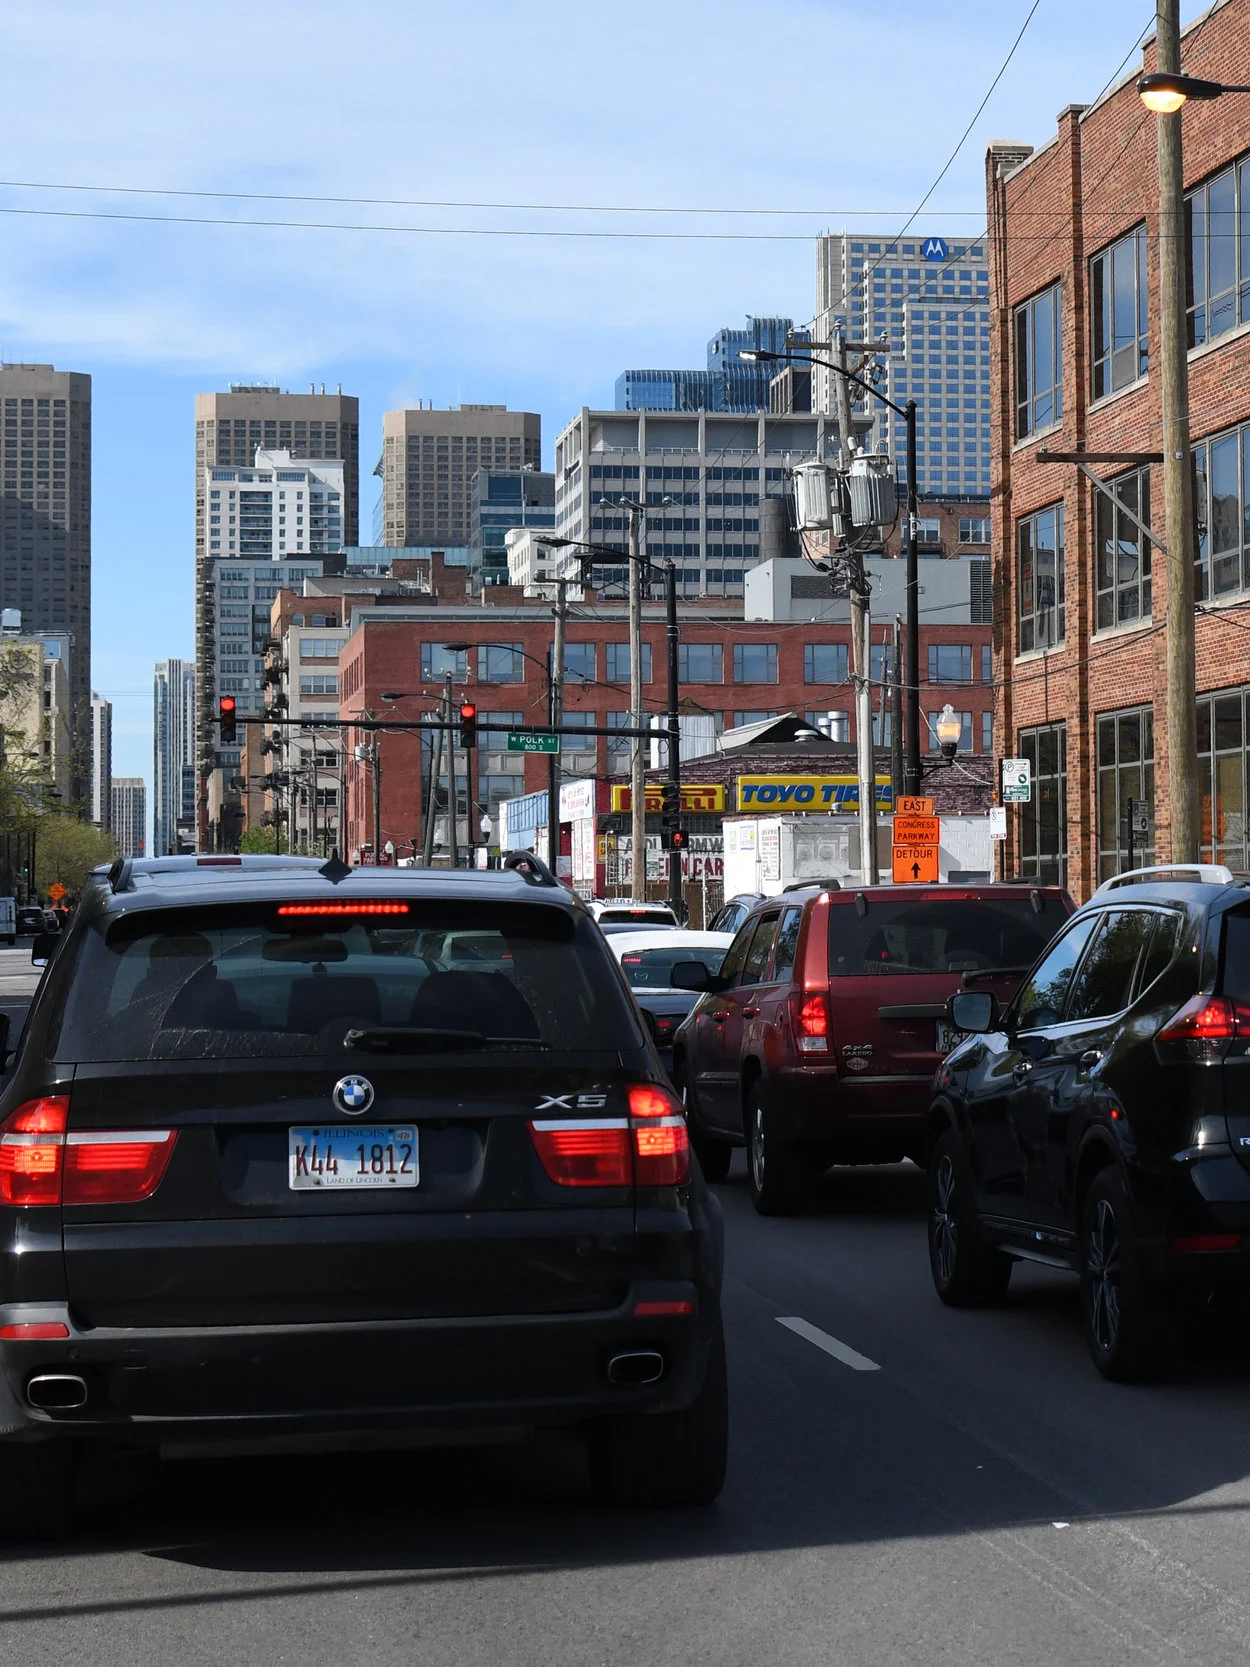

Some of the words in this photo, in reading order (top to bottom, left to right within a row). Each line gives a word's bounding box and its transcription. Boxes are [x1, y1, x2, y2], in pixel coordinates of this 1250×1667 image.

[520, 736, 544, 744] POLK
[620, 788, 717, 810] PRLLI
[742, 785, 814, 803] TOYO
[904, 801, 926, 812] EAST
[898, 820, 935, 829] CONGRESS
[896, 849, 932, 859] DETOUR
[535, 1093, 607, 1109] X5
[324, 1128, 384, 1138] ILLINOIS
[296, 1144, 338, 1176] K44
[356, 1143, 413, 1175] 1812
[355, 1176, 382, 1184] LINCOLN
